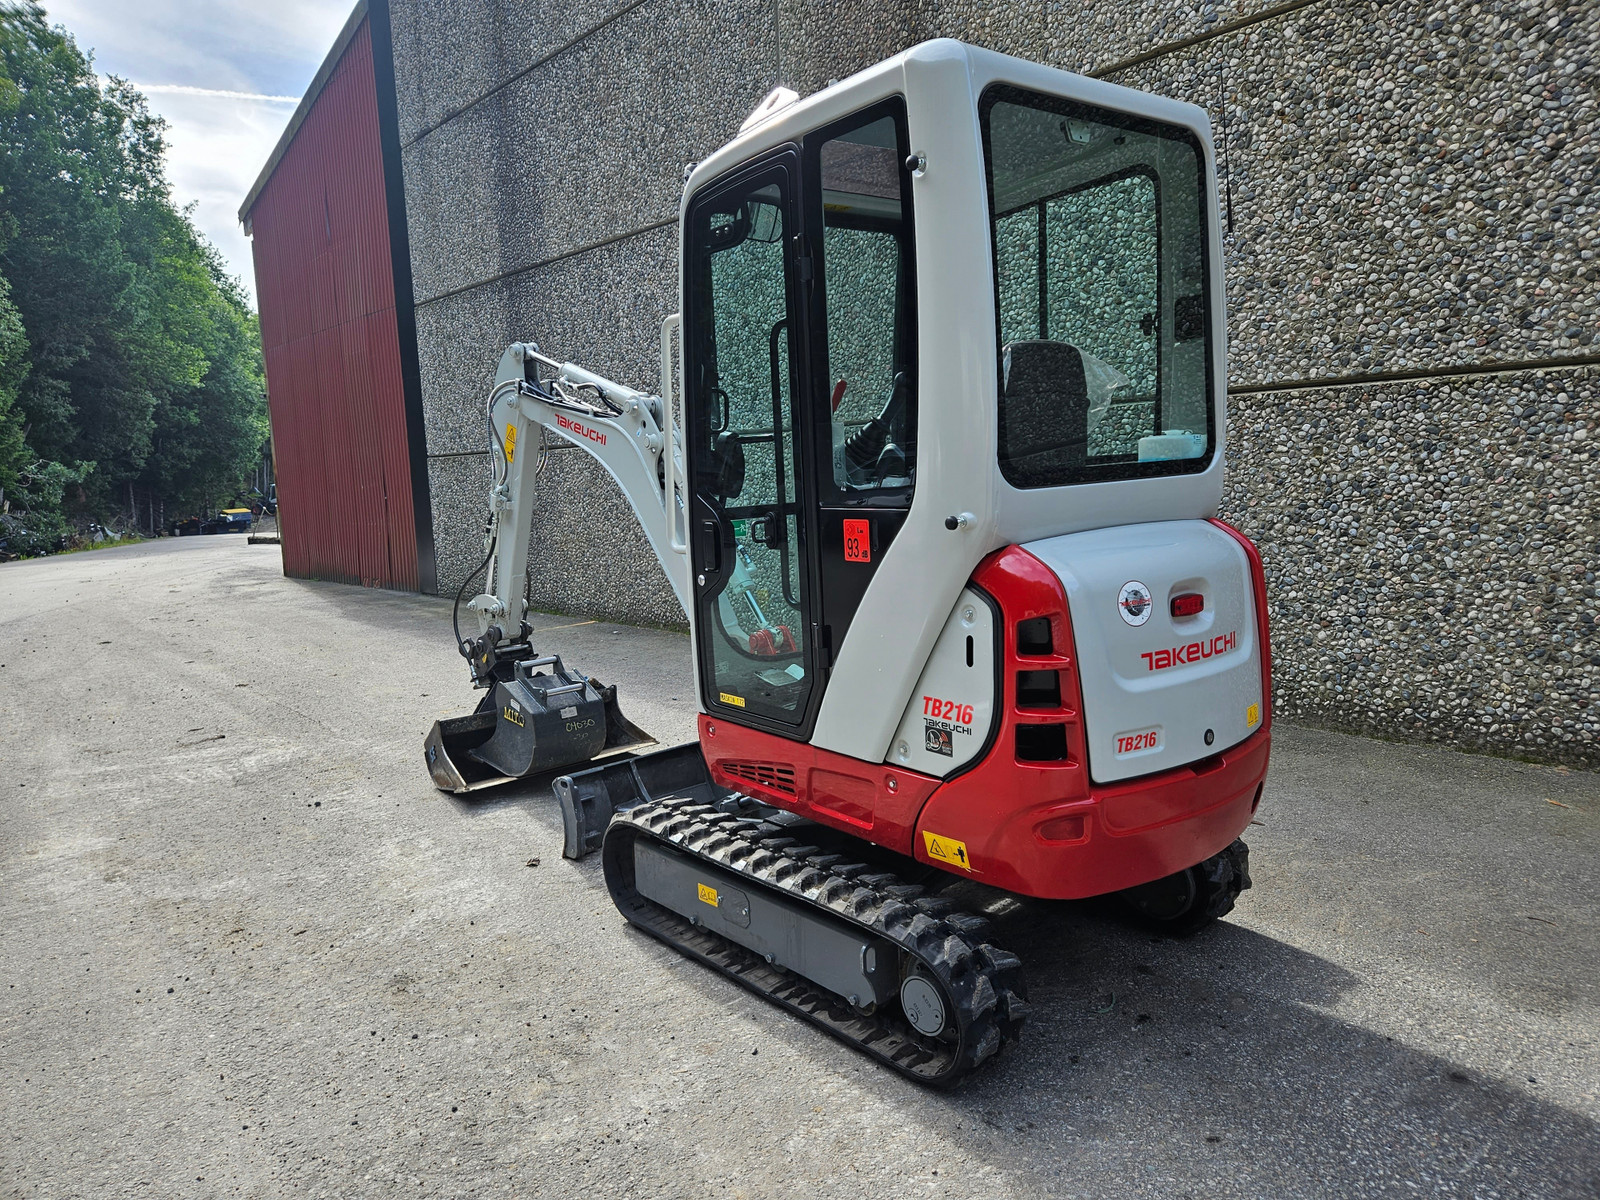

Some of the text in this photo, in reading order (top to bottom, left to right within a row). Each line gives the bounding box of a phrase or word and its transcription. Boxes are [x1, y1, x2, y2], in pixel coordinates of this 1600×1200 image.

[554, 413, 607, 446] TAKEUCHI
[847, 538, 860, 558] 93
[1140, 630, 1236, 671] TAKEUCHI
[923, 696, 974, 725] TB216
[565, 718, 596, 732] 04030
[923, 717, 972, 736] TAKEUCHI
[1117, 731, 1158, 754] TB216
